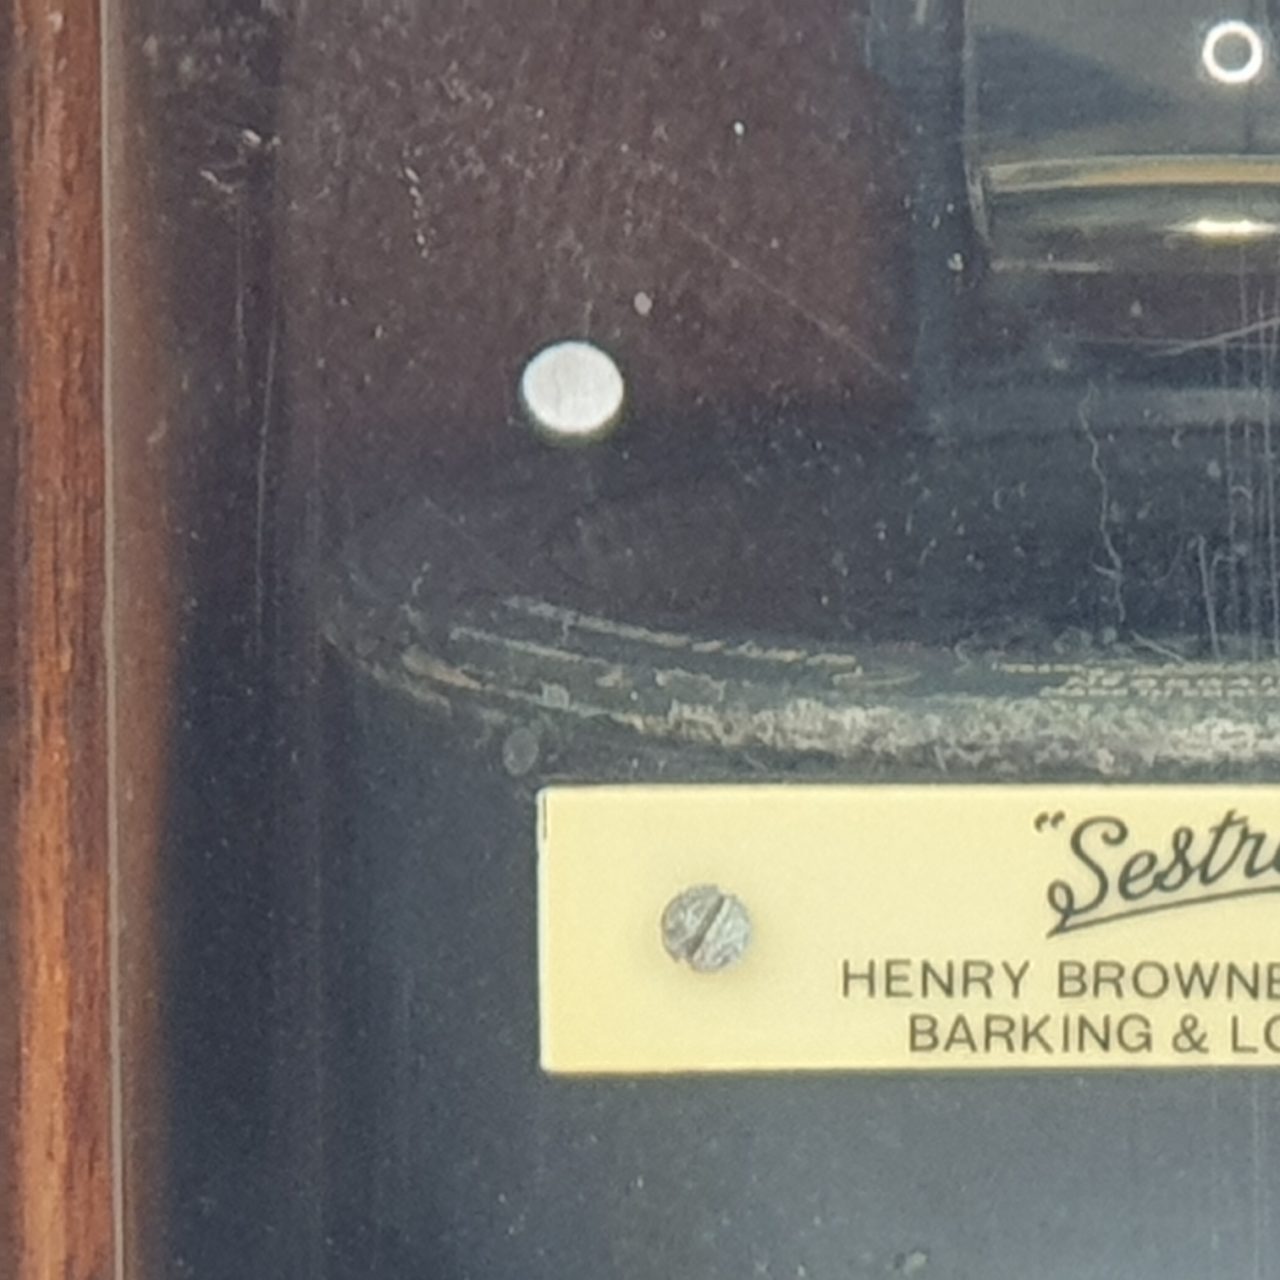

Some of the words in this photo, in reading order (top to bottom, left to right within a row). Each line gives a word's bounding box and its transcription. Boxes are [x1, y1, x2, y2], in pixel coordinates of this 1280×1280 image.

[841, 960, 1031, 999] HENRY
[909, 1014, 1152, 1053] BARKING
[1171, 1015, 1209, 1053] &
